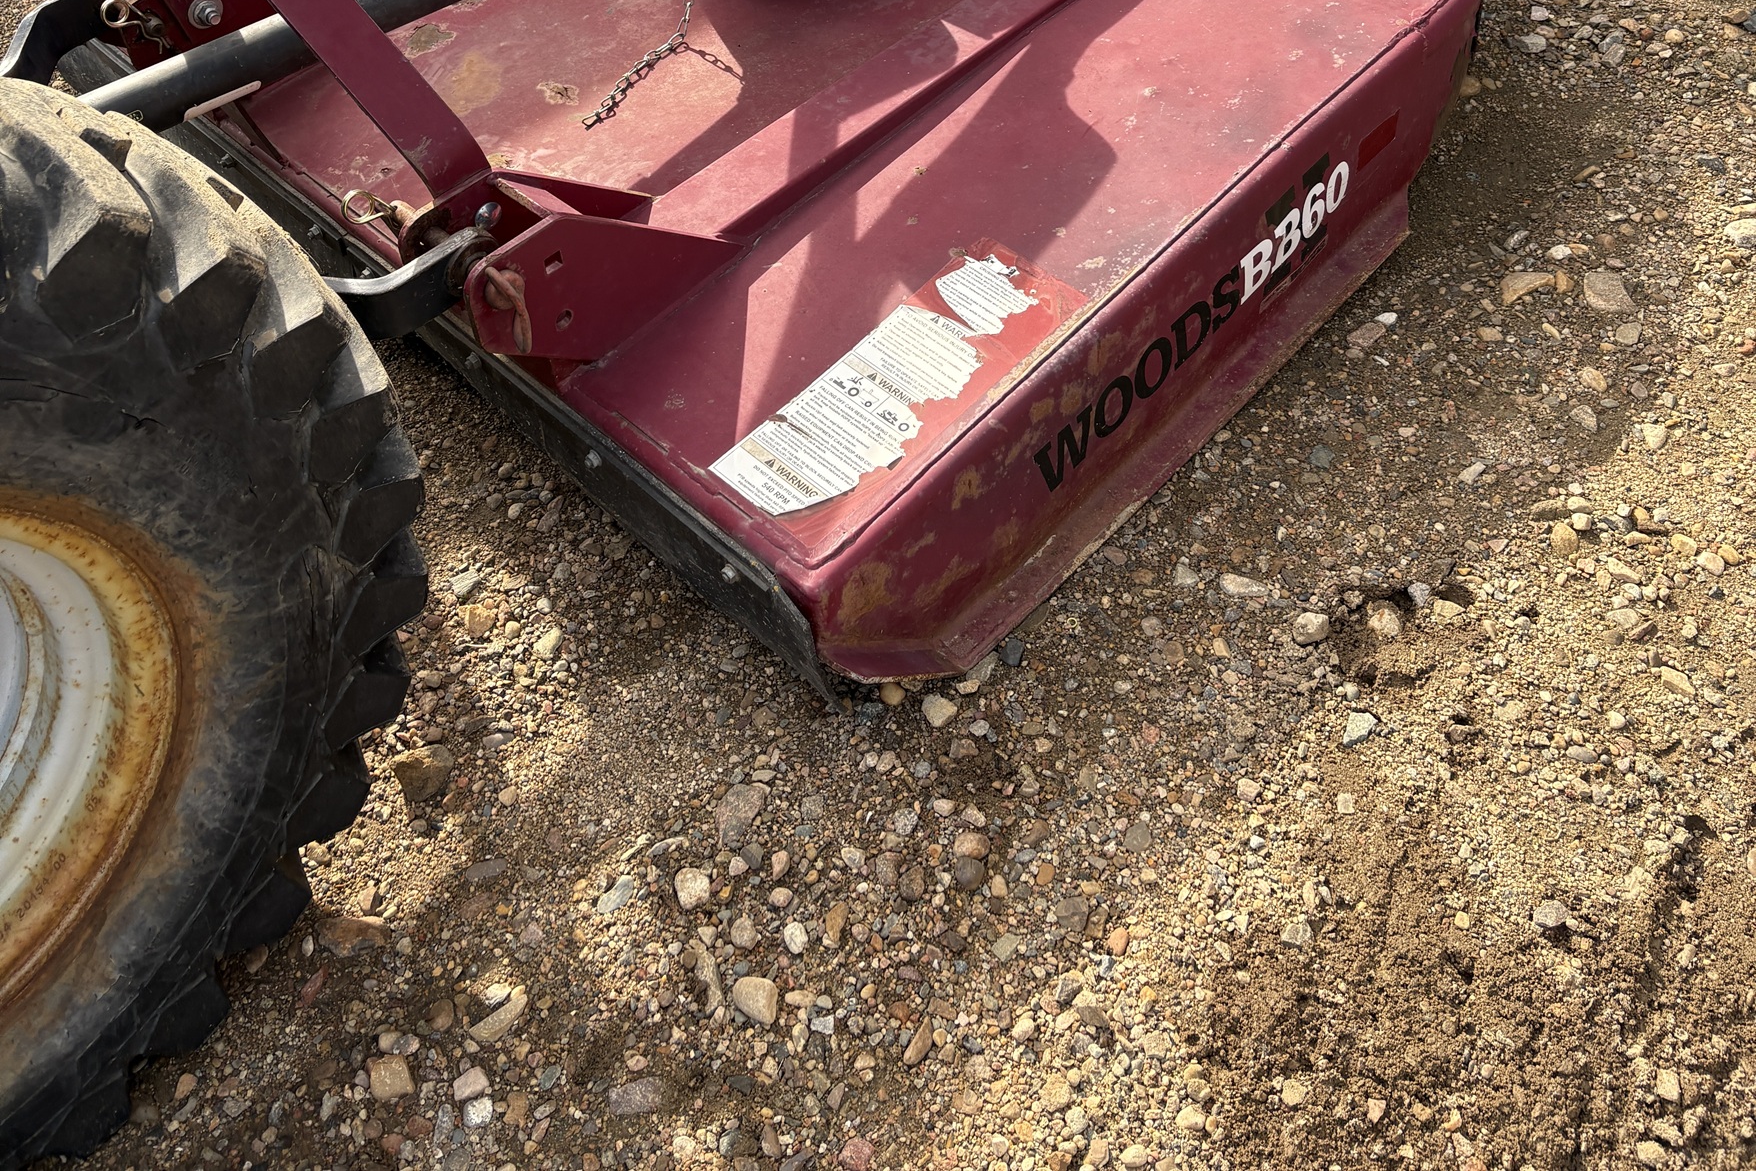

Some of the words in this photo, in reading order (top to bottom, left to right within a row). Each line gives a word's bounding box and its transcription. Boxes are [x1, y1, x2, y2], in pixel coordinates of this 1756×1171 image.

[1033, 266, 1241, 493] WOODS
[1240, 160, 1350, 305] BB60
[818, 384, 838, 399] FALLING
[835, 396, 845, 405] OFF
[843, 403, 855, 412] CAN
[852, 409, 871, 423] RESULT
[794, 409, 812, 423] RAISED
[809, 420, 834, 439] EQUIPMENT
[832, 437, 844, 446] CAN
[841, 444, 856, 455] DROP
[853, 453, 865, 462] AND
[758, 469, 769, 477] NOT
[767, 475, 784, 489] EXCEED
[782, 487, 792, 495] PTO
[790, 494, 806, 506] SPEED
[760, 481, 775, 493] 540
[772, 490, 791, 505] RPM
[775, 464, 819, 499] WARNING
